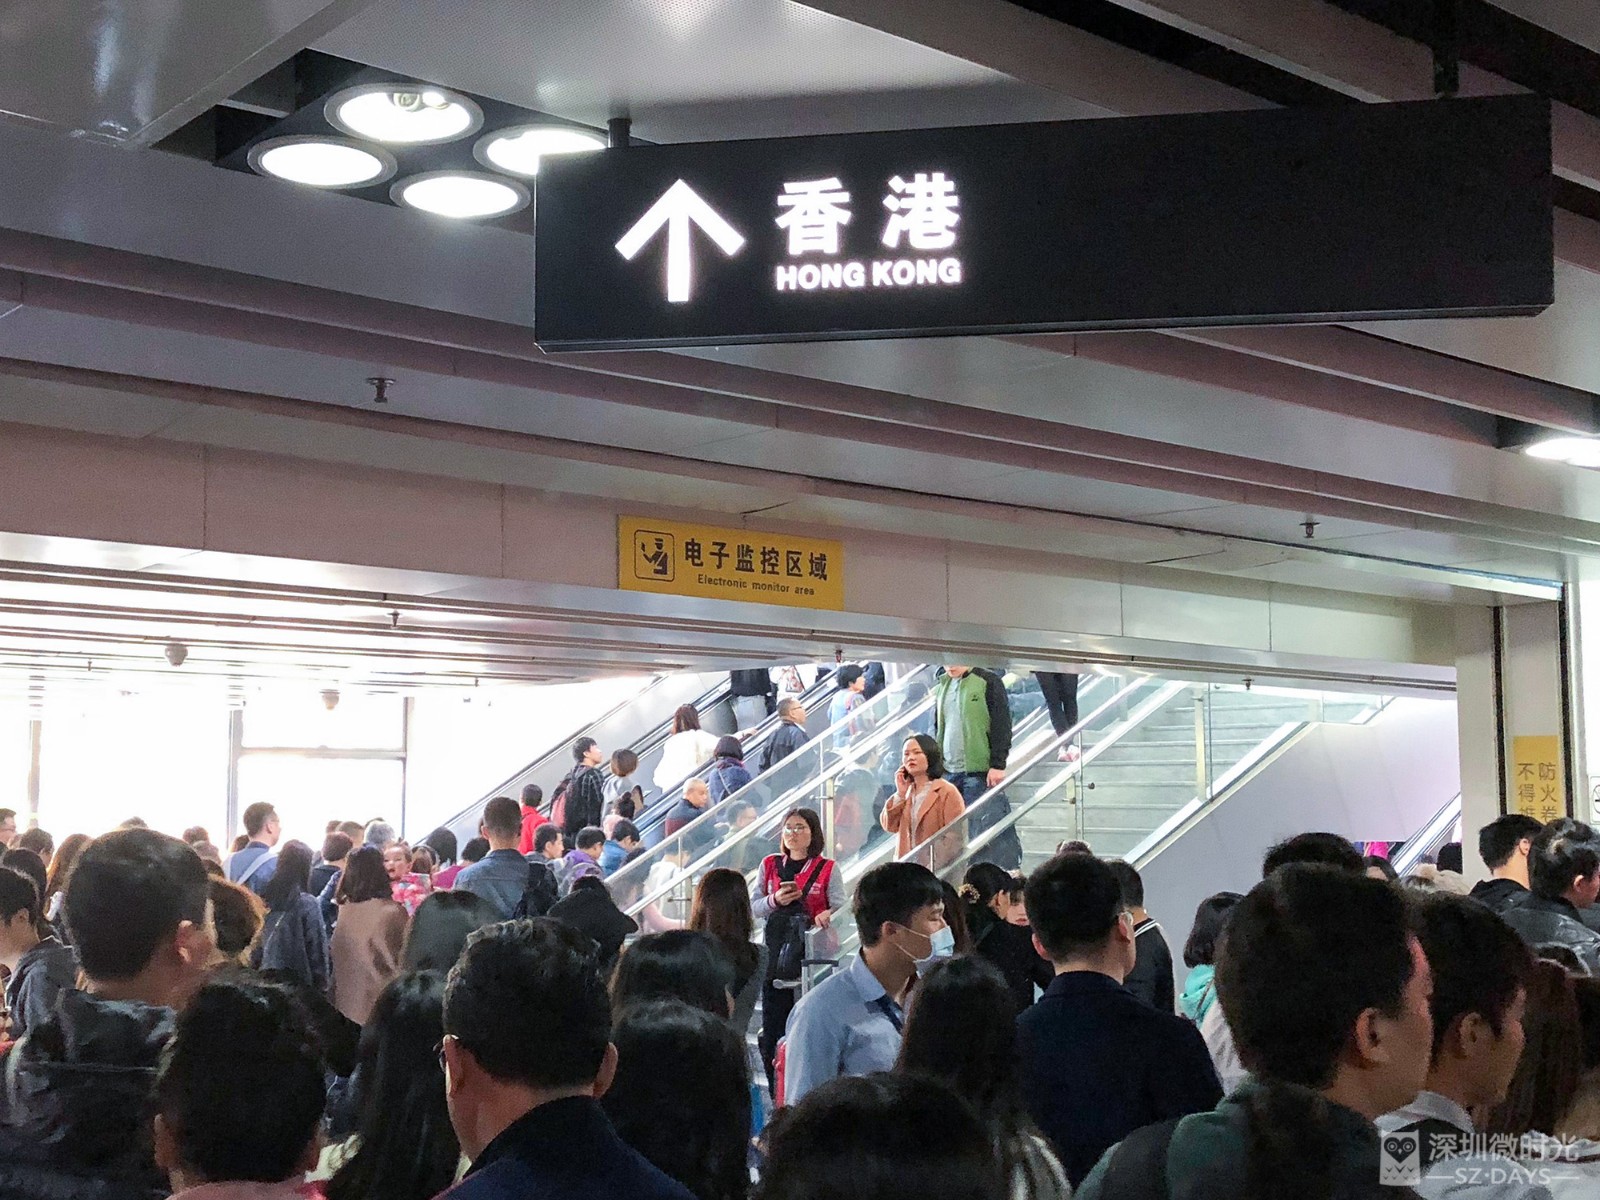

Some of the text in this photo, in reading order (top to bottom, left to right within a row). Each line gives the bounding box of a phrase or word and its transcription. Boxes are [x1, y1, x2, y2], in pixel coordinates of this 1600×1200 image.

[775, 172, 960, 255] 香港
[776, 258, 962, 290] HONG KONG
[684, 538, 828, 581] 电子监控区域
[697, 573, 815, 596] Electronic monitor area
